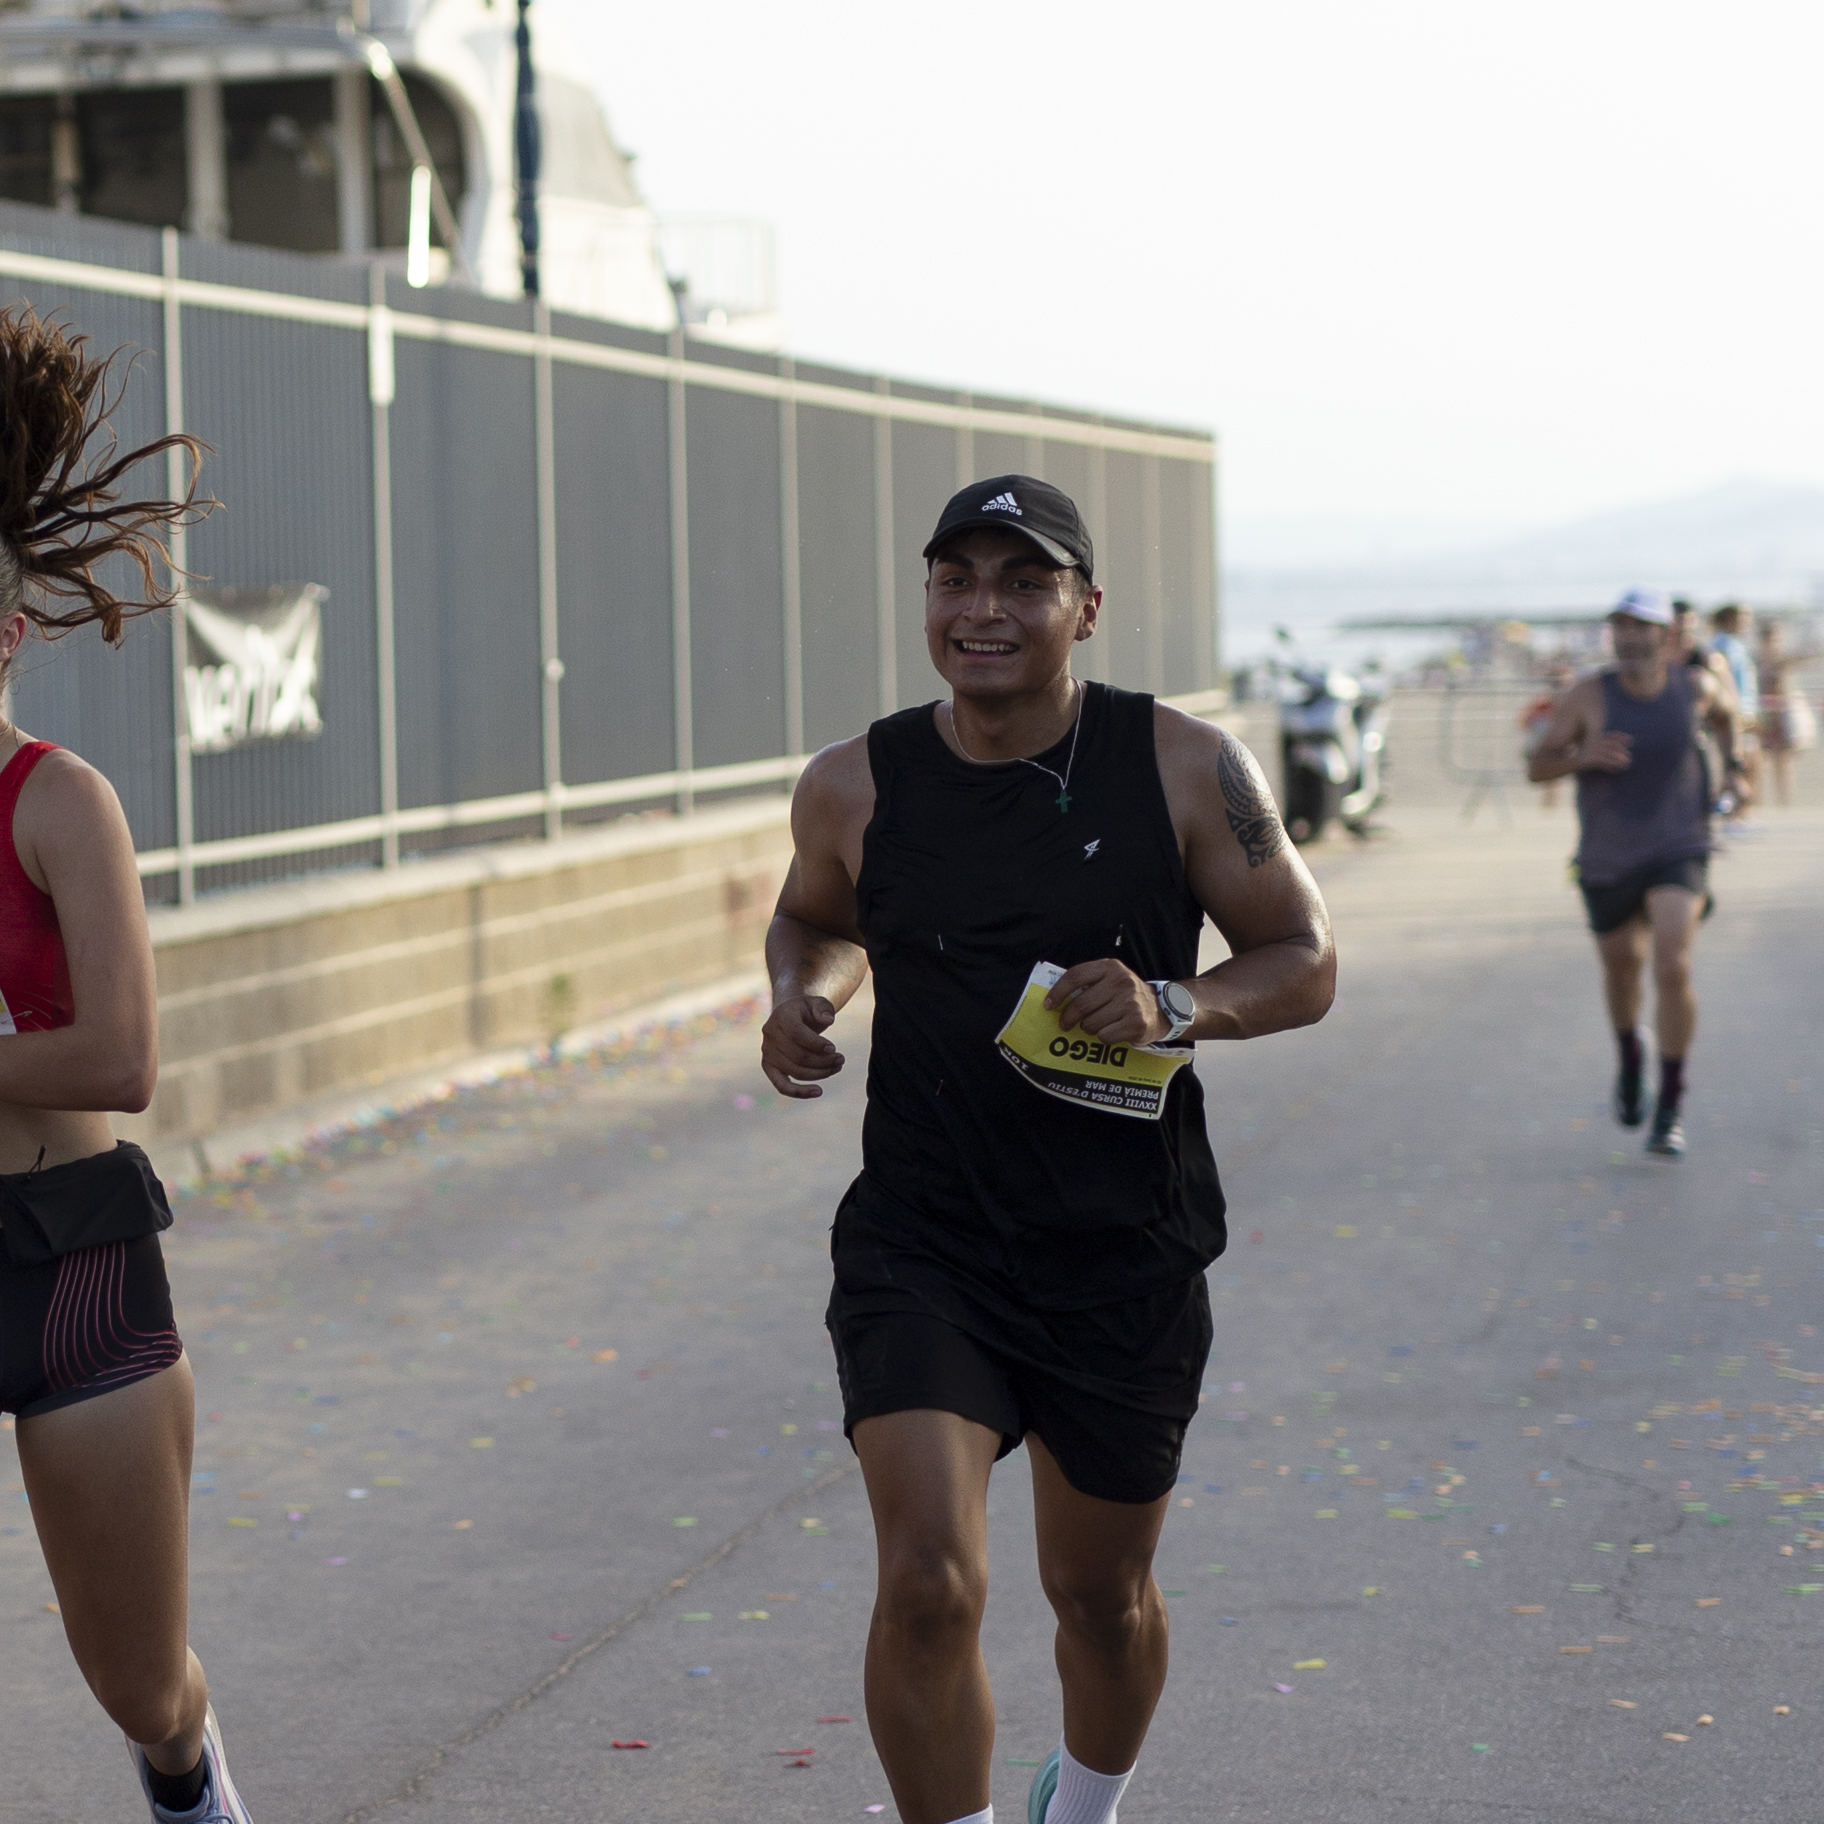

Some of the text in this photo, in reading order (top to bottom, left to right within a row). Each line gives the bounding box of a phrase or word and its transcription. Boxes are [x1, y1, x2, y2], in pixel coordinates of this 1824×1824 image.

[981, 501, 1023, 516] adidas
[1049, 1036, 1129, 1068] DIEGO
[1047, 1082, 1158, 1111] XXVIII CURSA D'ESTIU
[1085, 1080, 1160, 1100] PREMIÀ DE MAR
